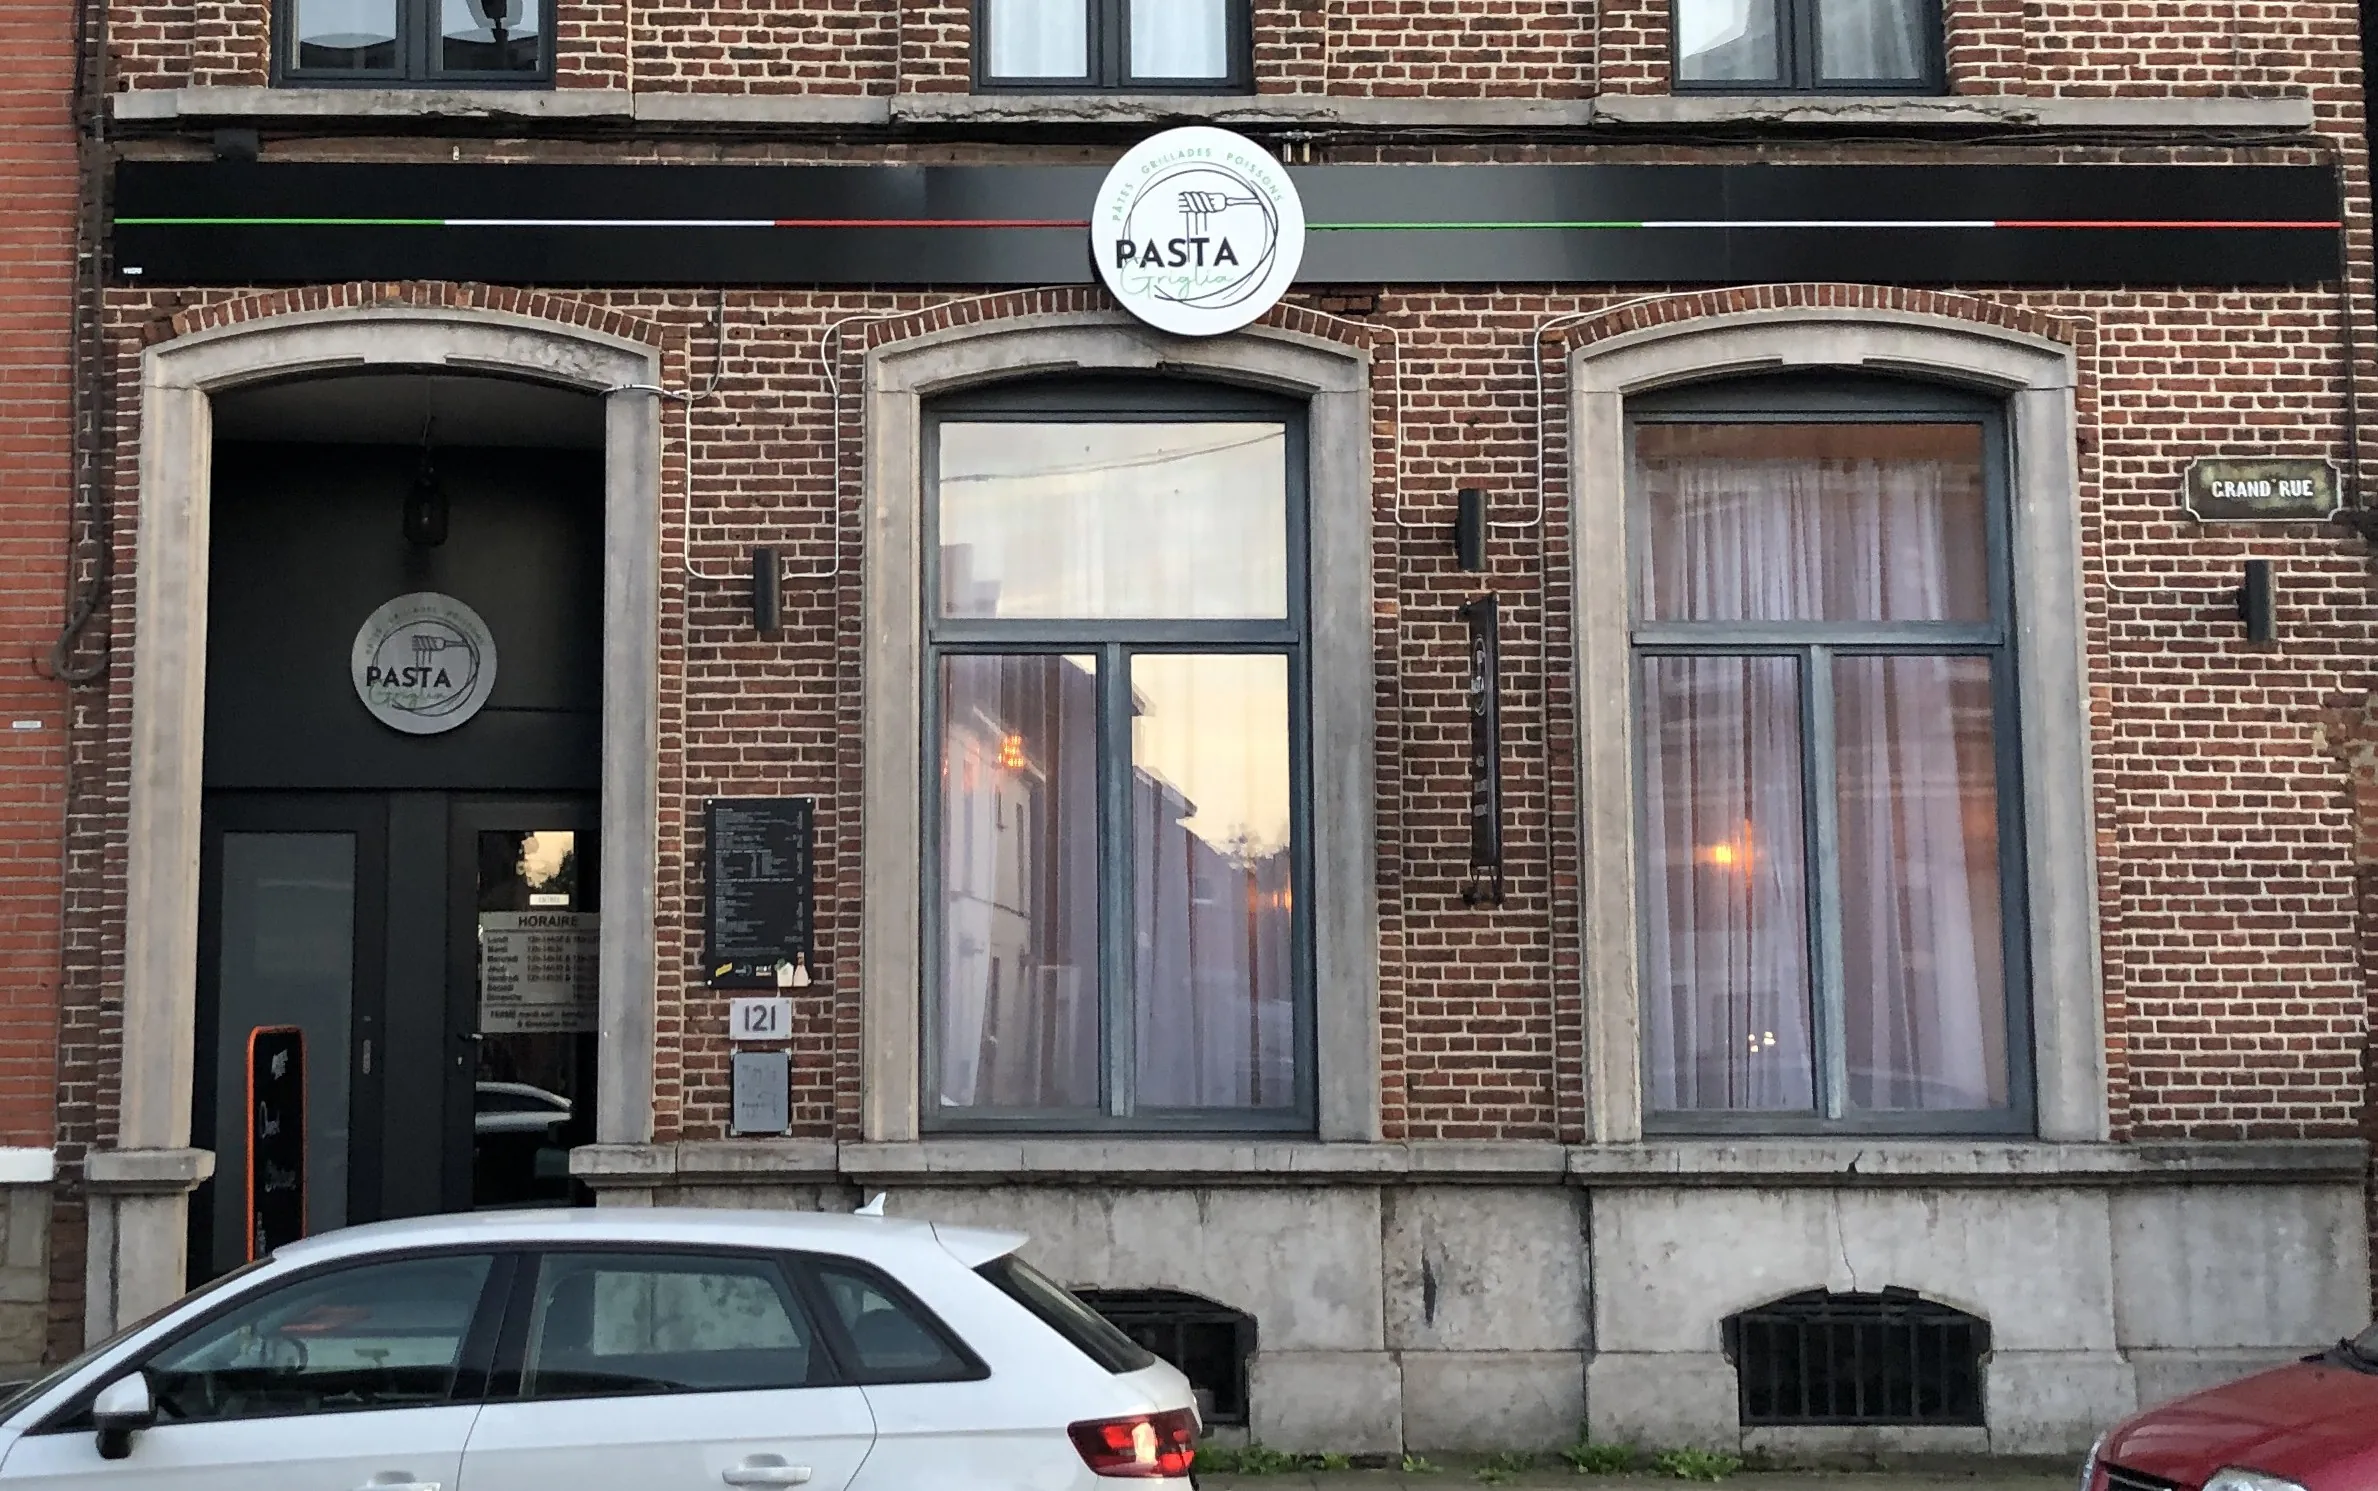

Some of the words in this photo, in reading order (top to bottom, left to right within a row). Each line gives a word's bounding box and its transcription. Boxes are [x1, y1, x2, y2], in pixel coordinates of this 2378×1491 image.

[1141, 148, 1212, 174] GRILLADES
[1226, 152, 1284, 202] POISSONS
[1115, 236, 1240, 269] PASTA
[1120, 257, 1234, 299] Griglia
[2279, 480, 2313, 497] RUE
[366, 666, 451, 688] PASTA
[518, 915, 578, 928] HORAIRE
[744, 1004, 776, 1032] 121
